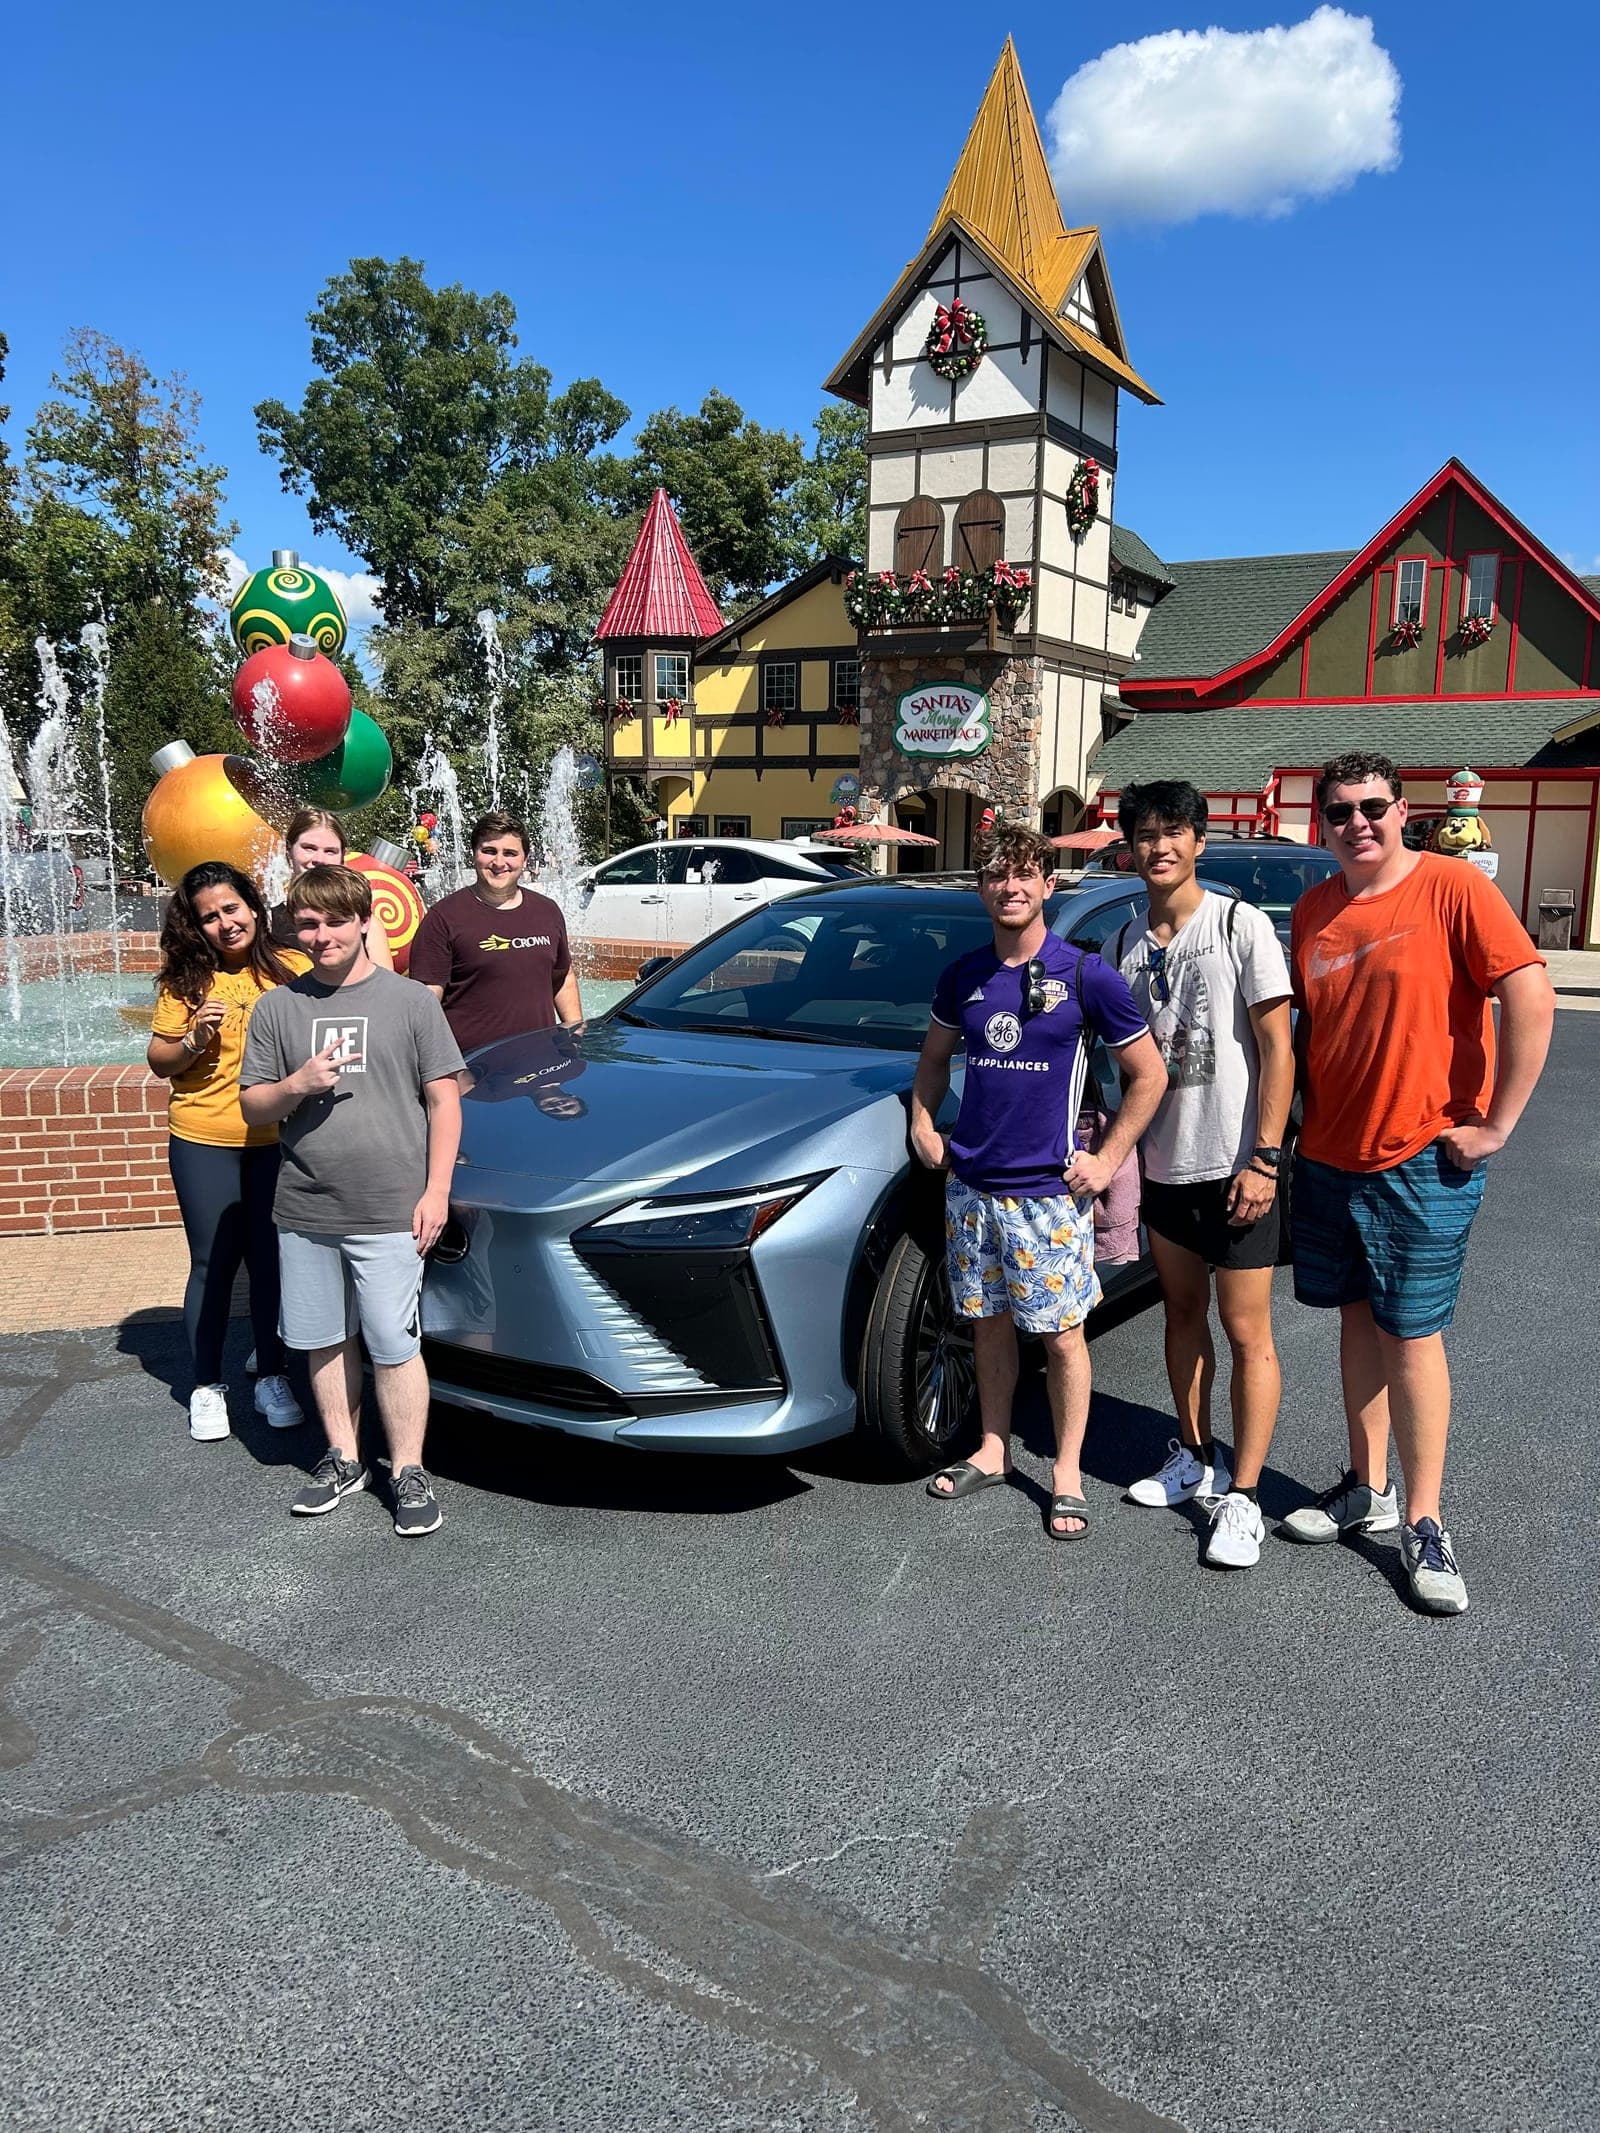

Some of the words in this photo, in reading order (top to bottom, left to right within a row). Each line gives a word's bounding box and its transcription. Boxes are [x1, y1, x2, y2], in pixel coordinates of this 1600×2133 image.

[911, 694, 972, 715] SANTA'S
[920, 710, 962, 728] Merry
[904, 728, 981, 742] MARKETPLACE
[511, 936, 551, 949] CROWN
[1178, 944, 1215, 963] Heart
[977, 1058, 1050, 1072] APPLIANCES
